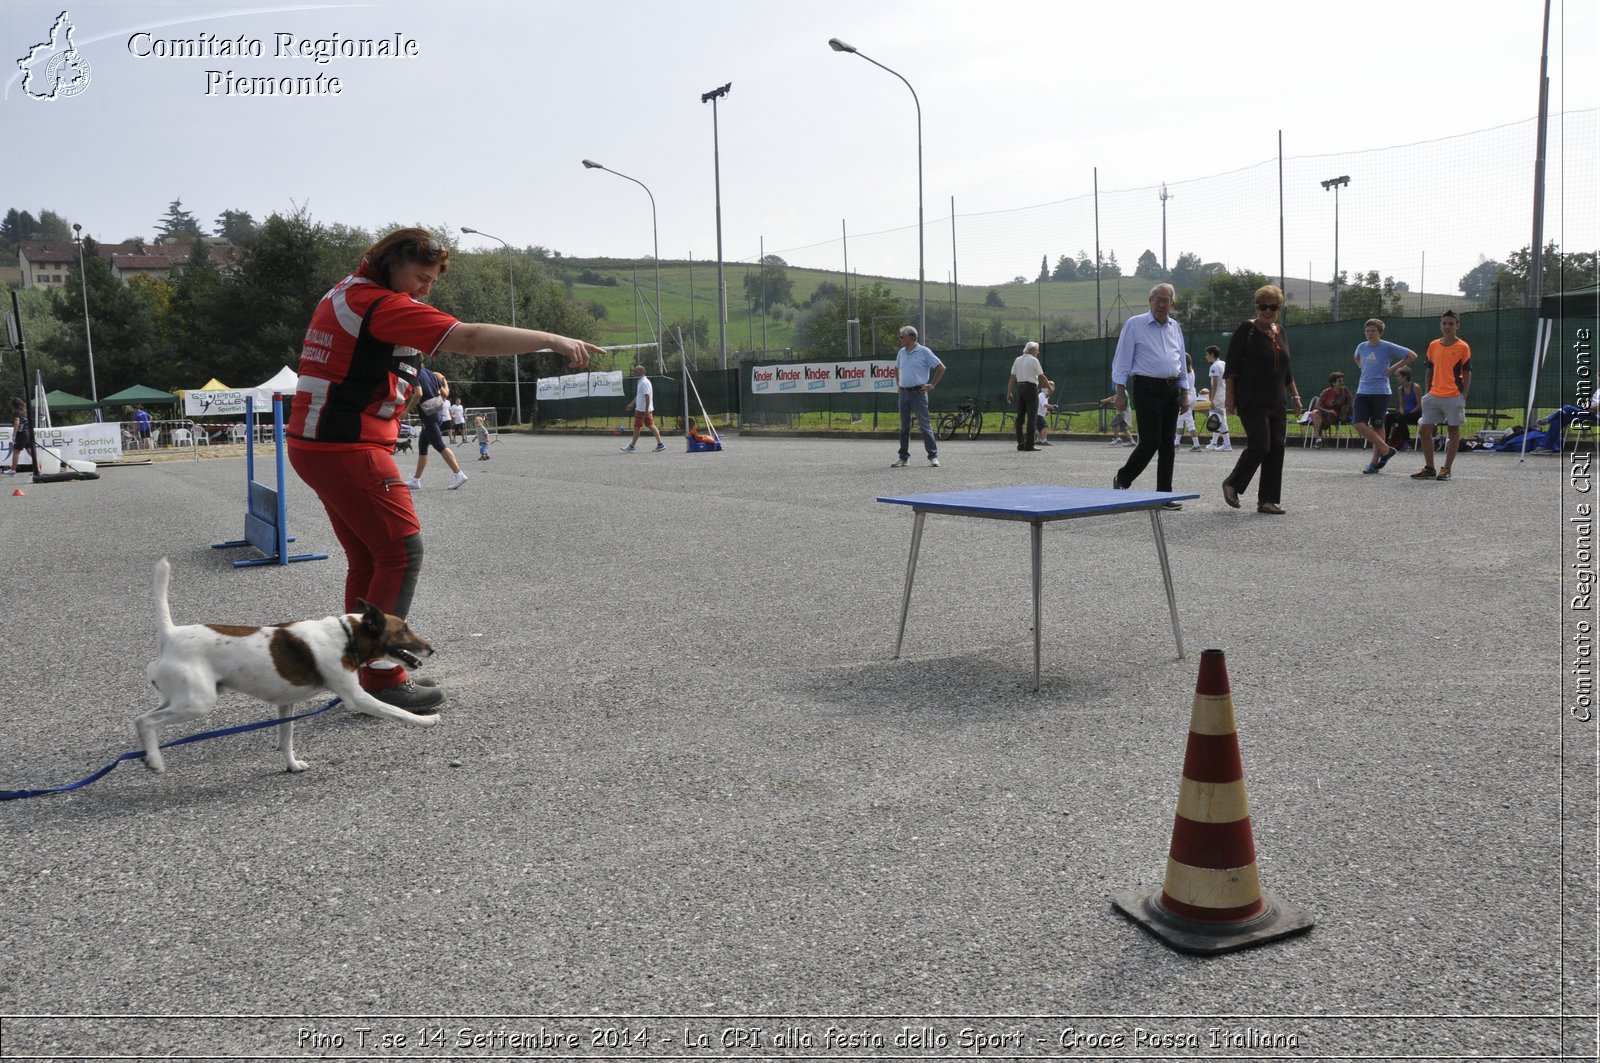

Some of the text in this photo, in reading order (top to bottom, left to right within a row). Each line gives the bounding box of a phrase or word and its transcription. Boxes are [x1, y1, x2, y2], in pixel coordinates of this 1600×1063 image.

[78, 438, 114, 447] Sportivi
[78, 447, 118, 456] si cresce
